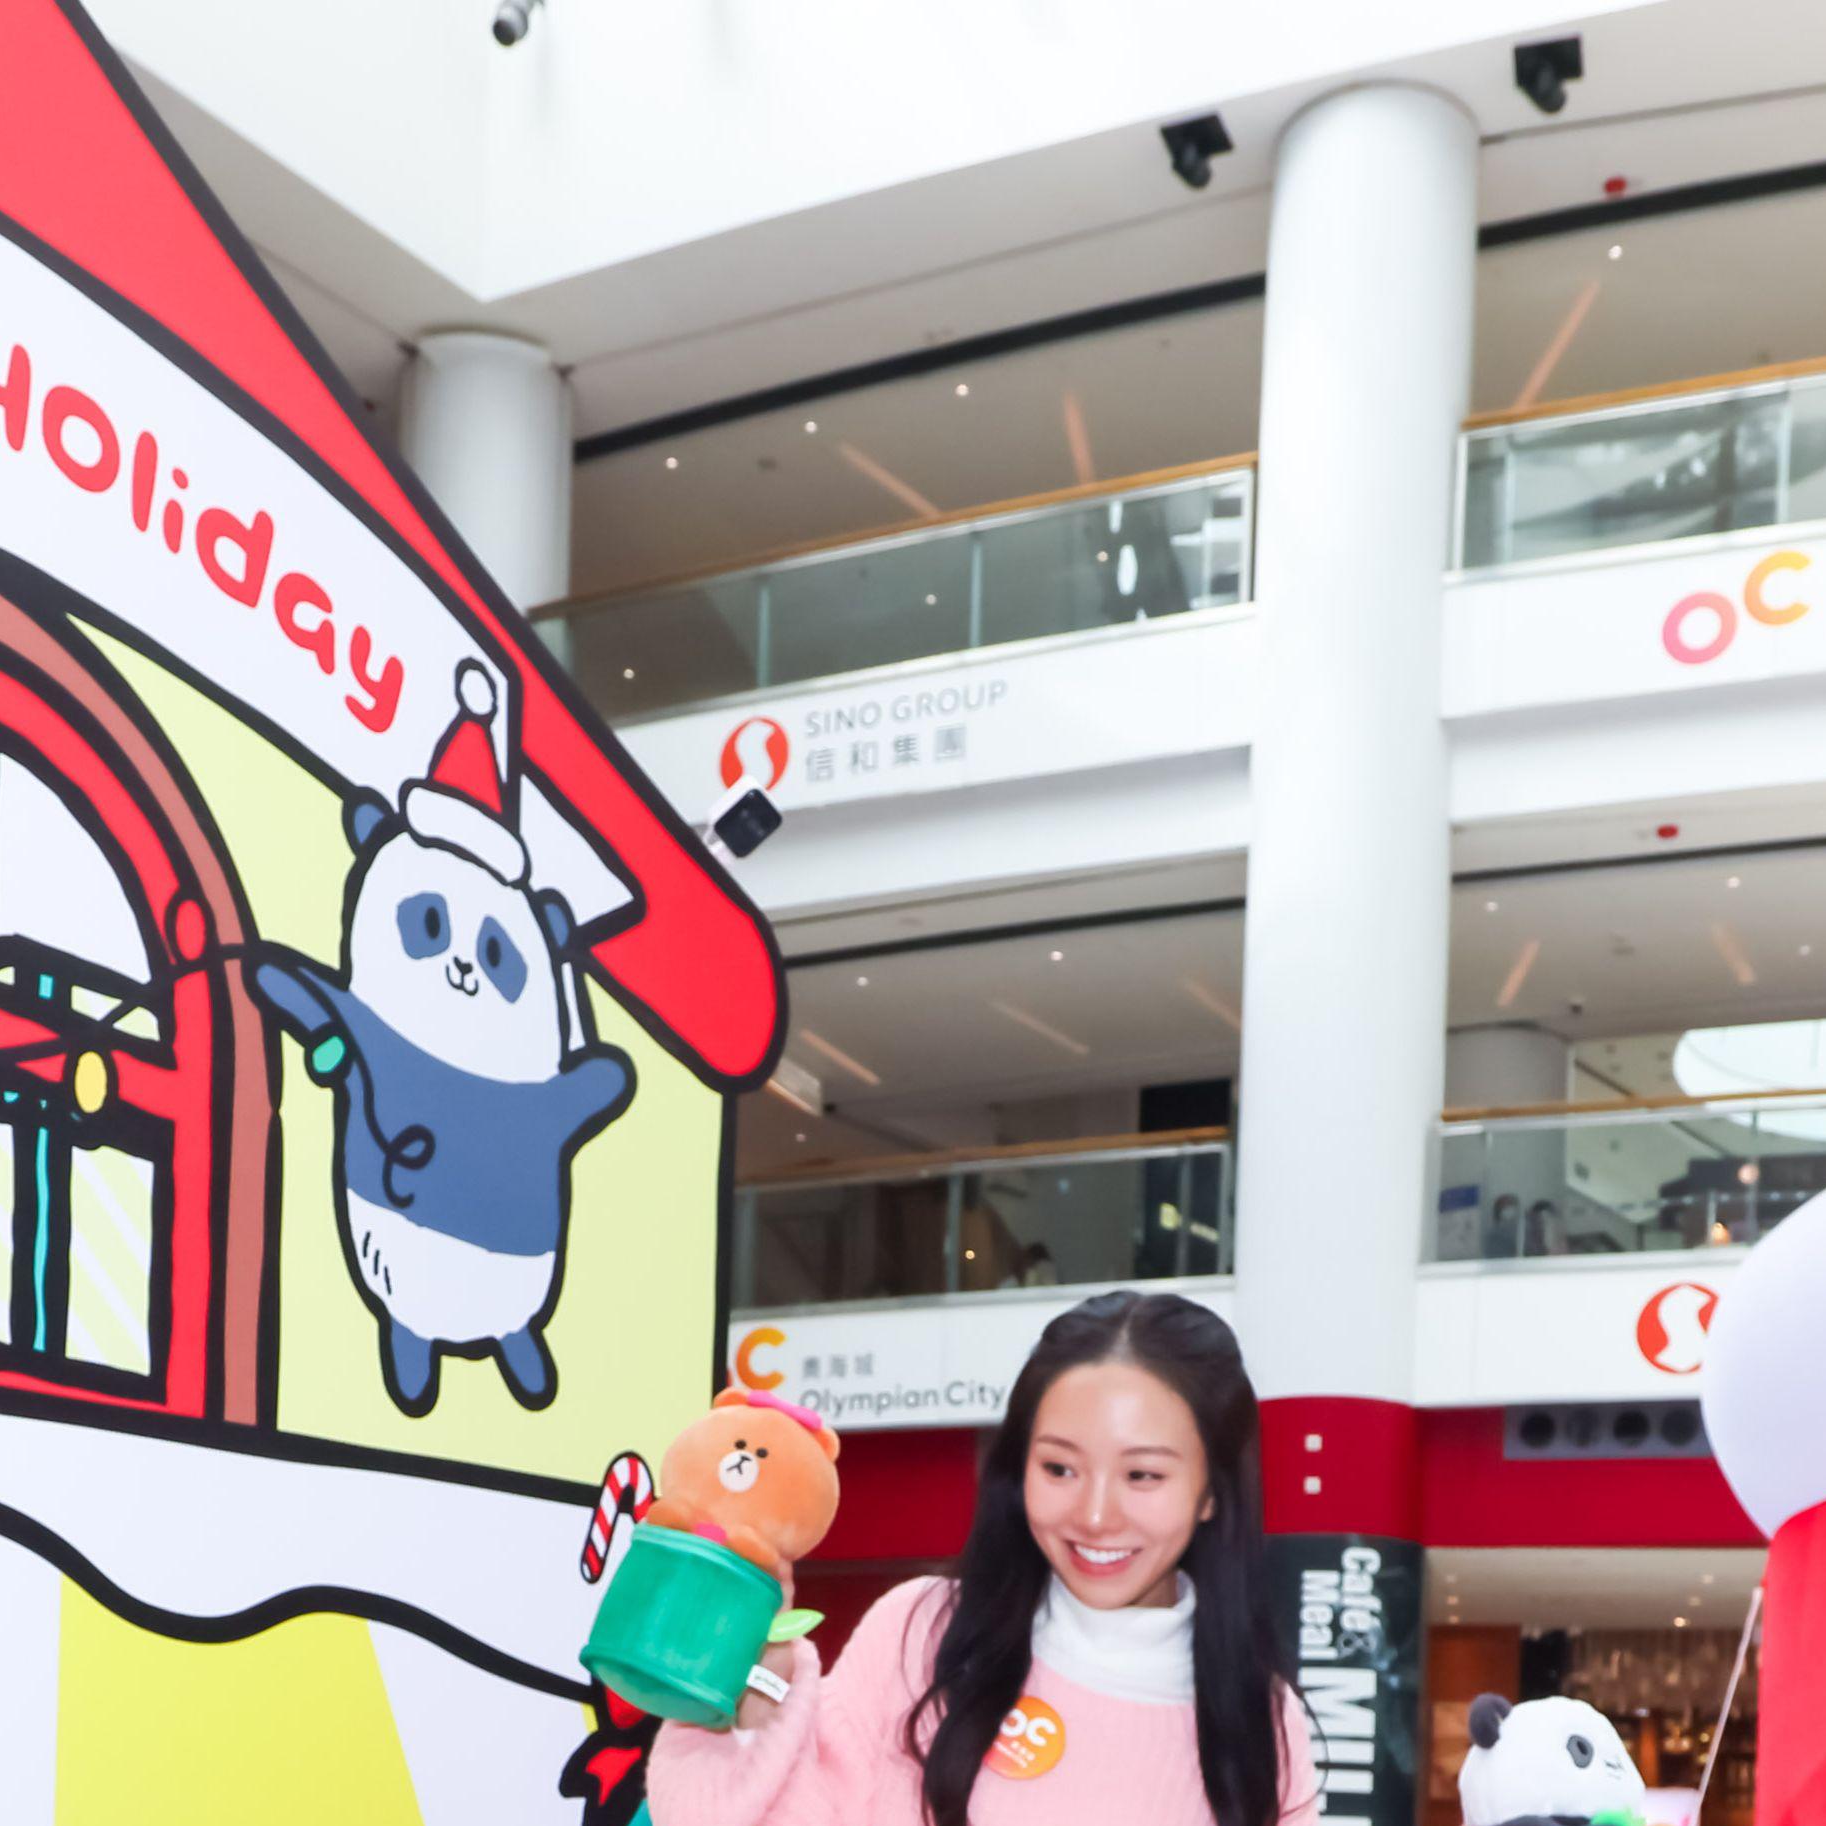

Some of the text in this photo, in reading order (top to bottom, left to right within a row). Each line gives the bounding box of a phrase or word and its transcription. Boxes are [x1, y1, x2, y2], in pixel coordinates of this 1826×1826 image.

[1662, 549, 1812, 665] OC
[805, 680, 1008, 738] SINO GROUP
[728, 1326, 787, 1391] C
[1299, 1569, 1340, 1660] Meal
